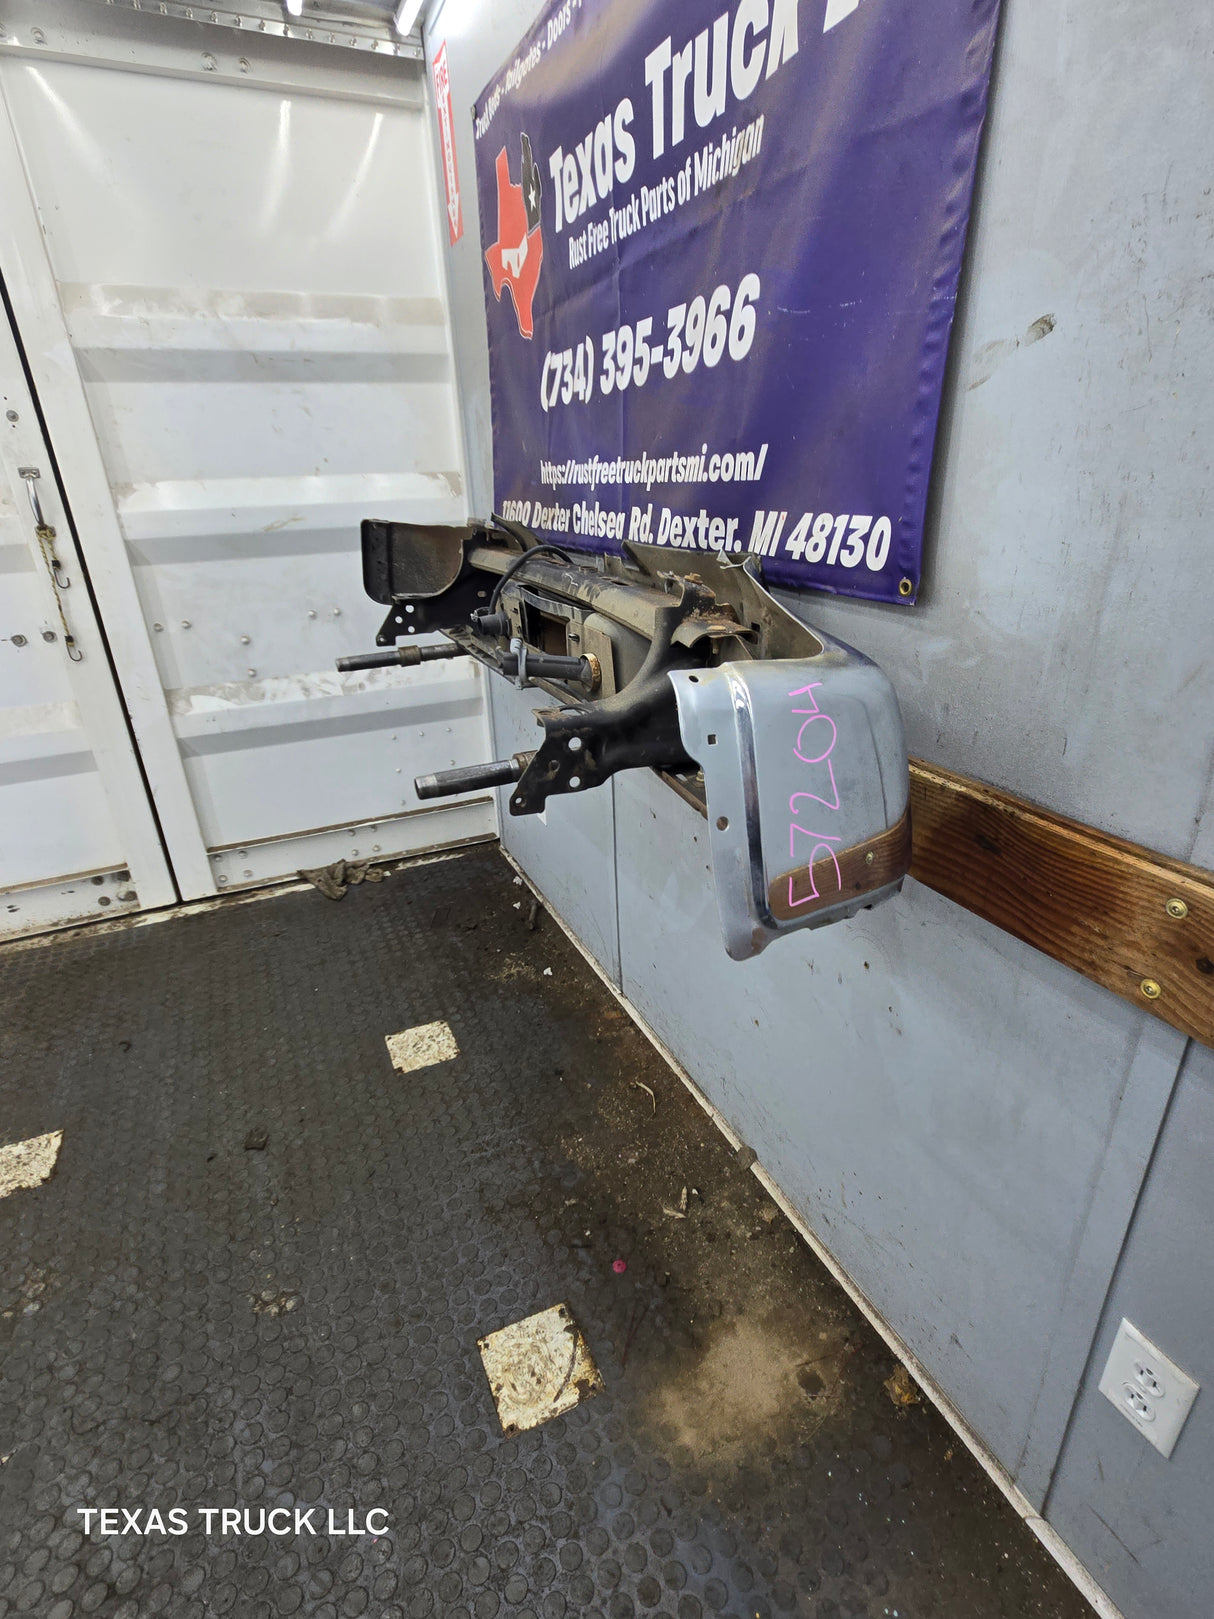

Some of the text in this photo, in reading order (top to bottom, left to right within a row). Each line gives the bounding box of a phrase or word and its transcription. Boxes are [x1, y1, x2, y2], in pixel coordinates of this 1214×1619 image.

[547, 0, 572, 50] Doors
[549, 98, 636, 234] Texas
[568, 113, 765, 270] Rust Free Truck Parts of Michigan
[540, 272, 761, 412] (734) 395-3966
[502, 499, 892, 572] 11600 Dexter Chelsea Rd. Dexter. MI 48130
[540, 443, 769, 492] https://rustfreetruckpartsmi.com/
[788, 682, 842, 907] 57204
